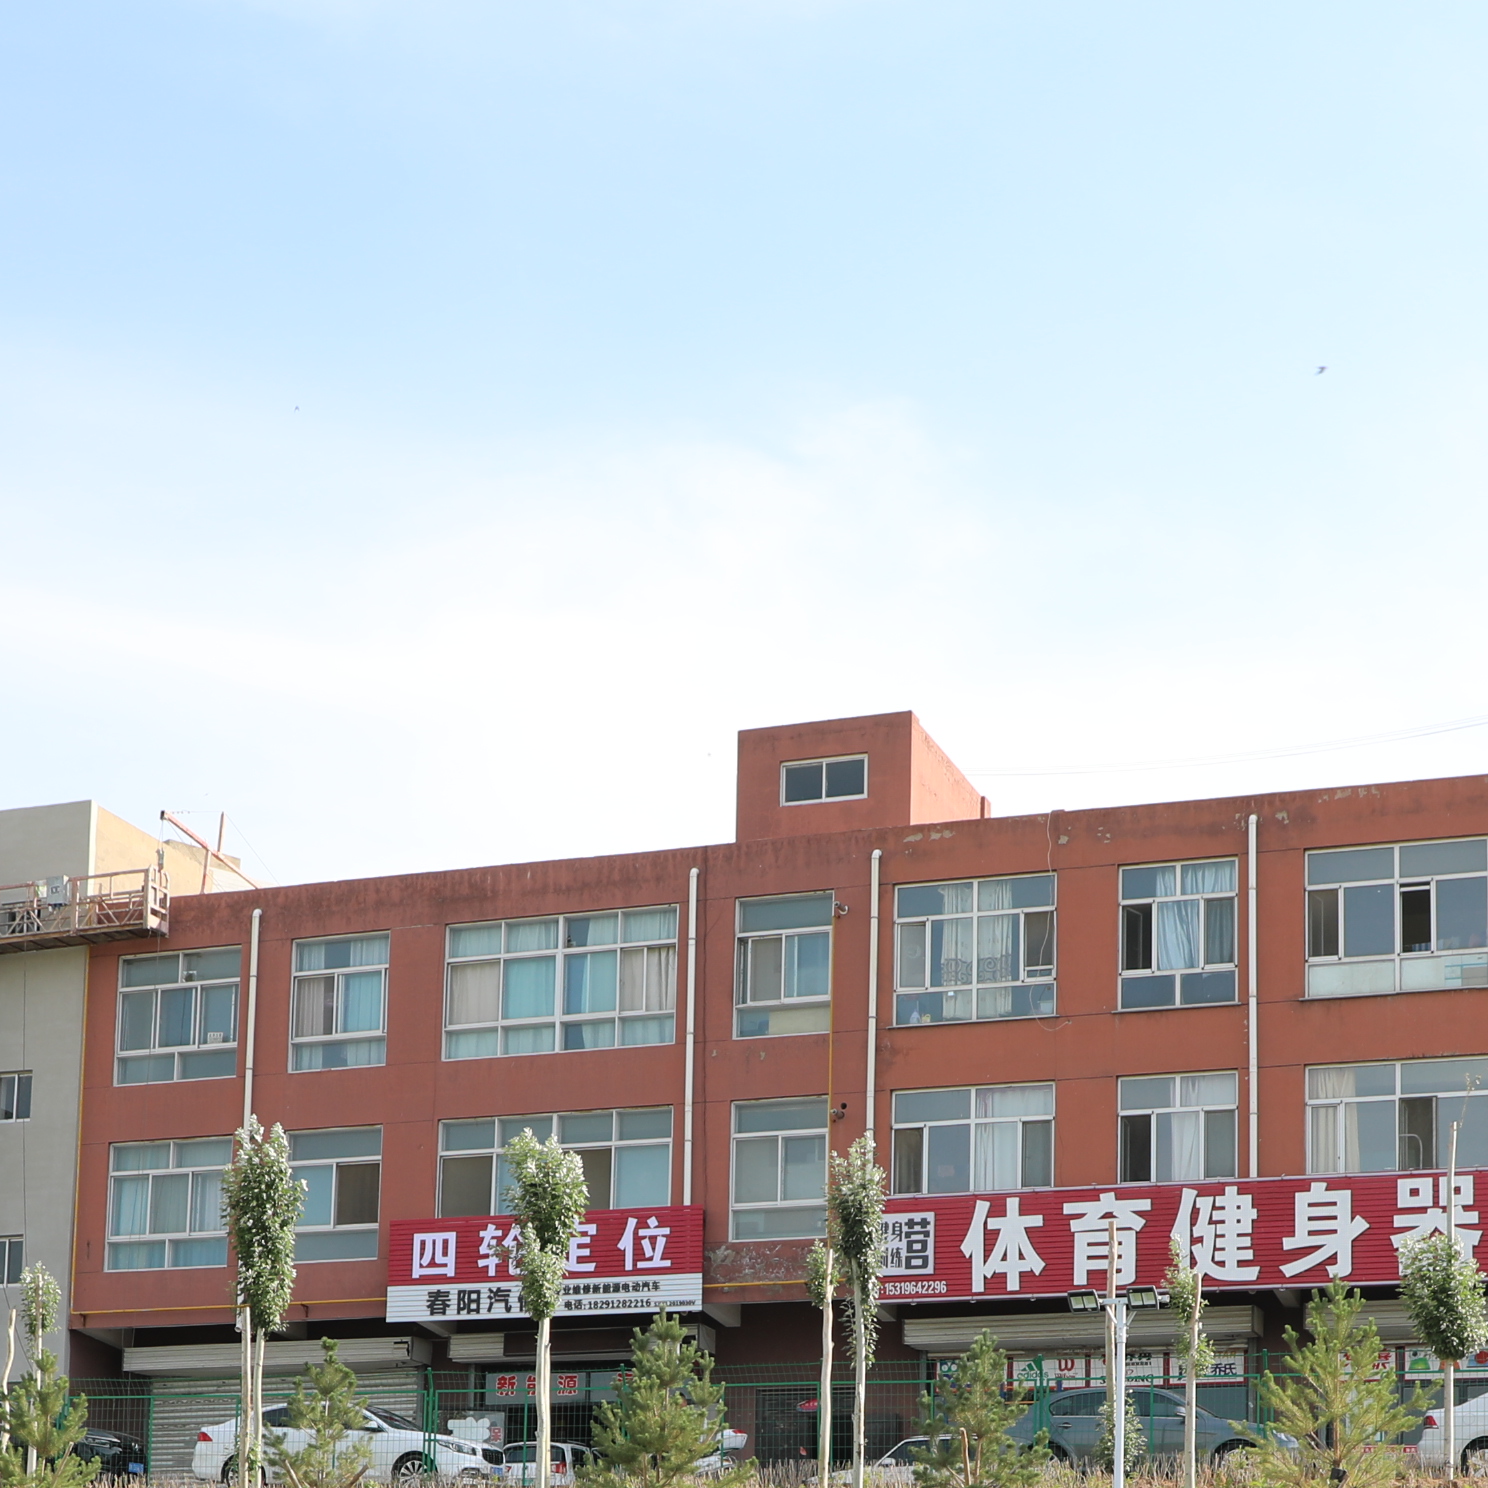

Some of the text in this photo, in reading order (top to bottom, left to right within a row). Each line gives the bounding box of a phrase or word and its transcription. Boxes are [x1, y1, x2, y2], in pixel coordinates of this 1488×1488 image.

[557, 1281, 661, 1295] 业维修新能源电动汽车
[426, 1287, 527, 1316] 春阳汽
